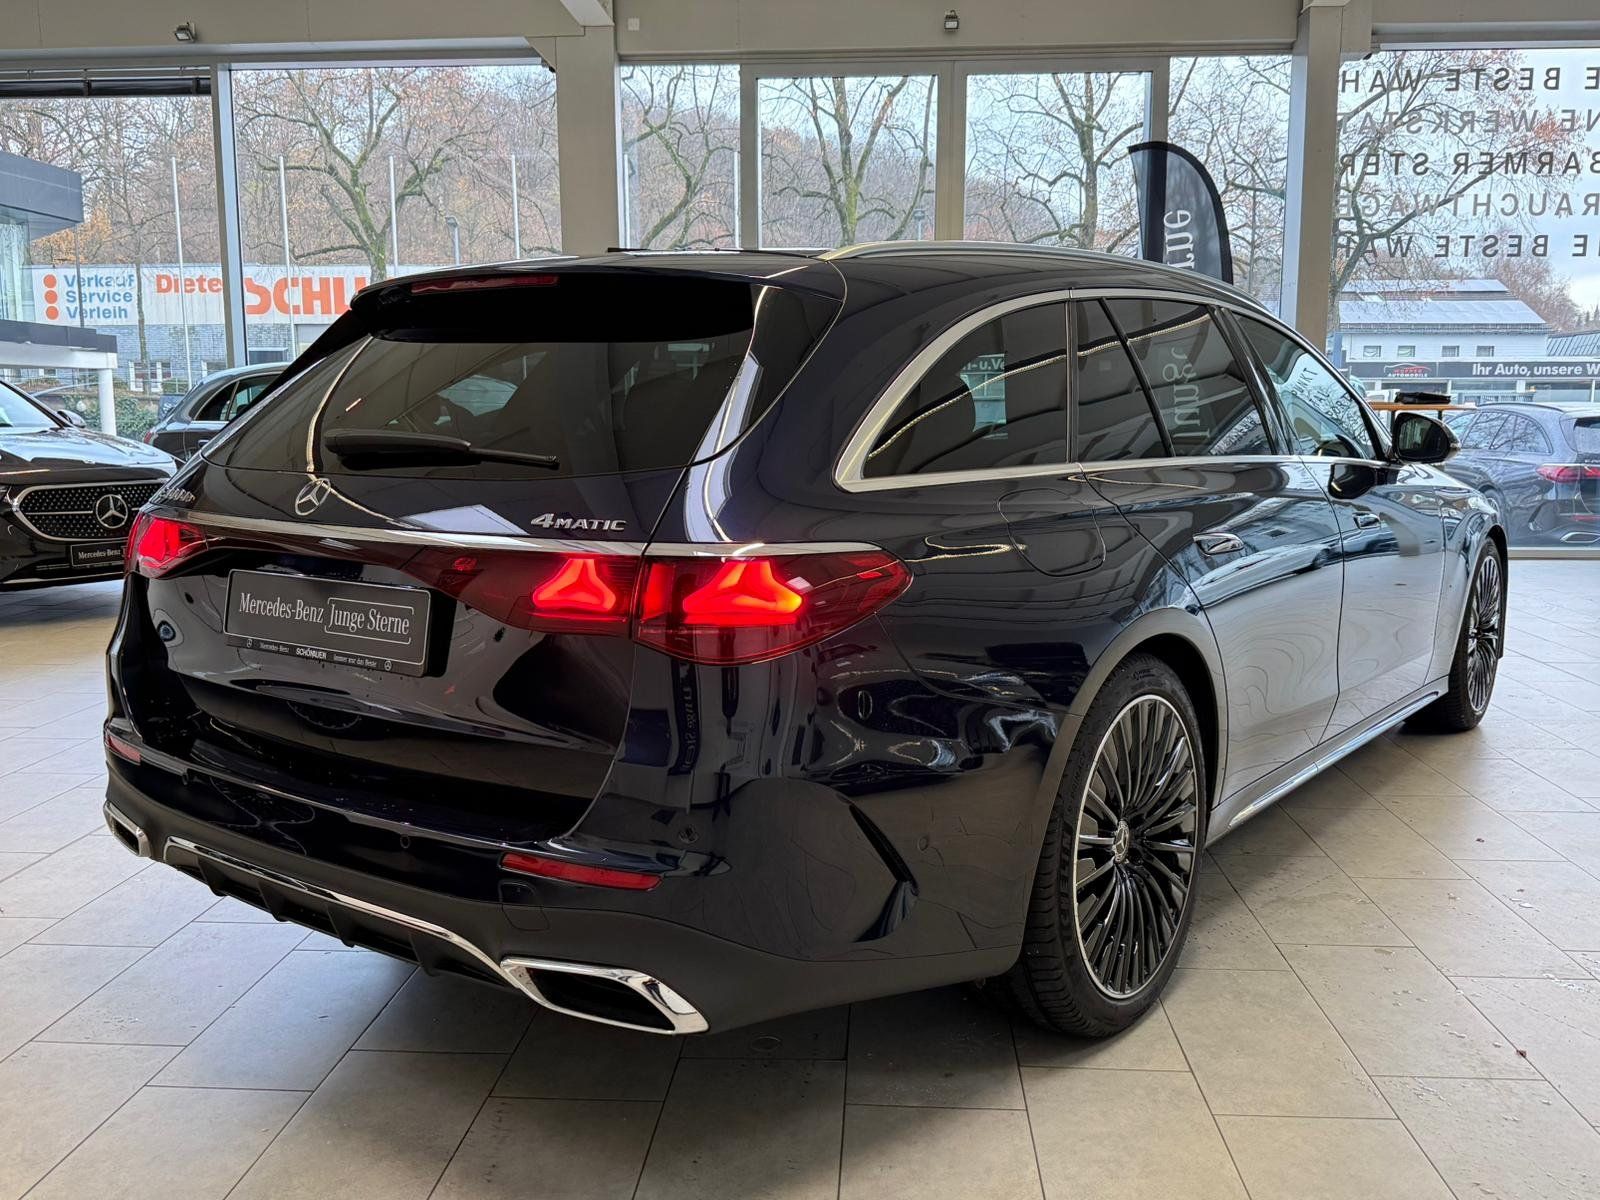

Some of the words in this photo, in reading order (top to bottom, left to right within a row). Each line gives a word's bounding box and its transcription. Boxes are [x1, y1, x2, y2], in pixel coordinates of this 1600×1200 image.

[64, 274, 134, 287] Verkauf
[66, 290, 133, 303] Service
[66, 305, 128, 319] Verleih
[1472, 363, 1492, 376] Ihr
[1494, 363, 1531, 377] Auto,
[1533, 364, 1583, 376] unsere
[530, 513, 627, 531] 4MATIC
[239, 592, 324, 623] Mercedes-Benz
[328, 604, 365, 633] Junge
[367, 608, 410, 635] Sterne
